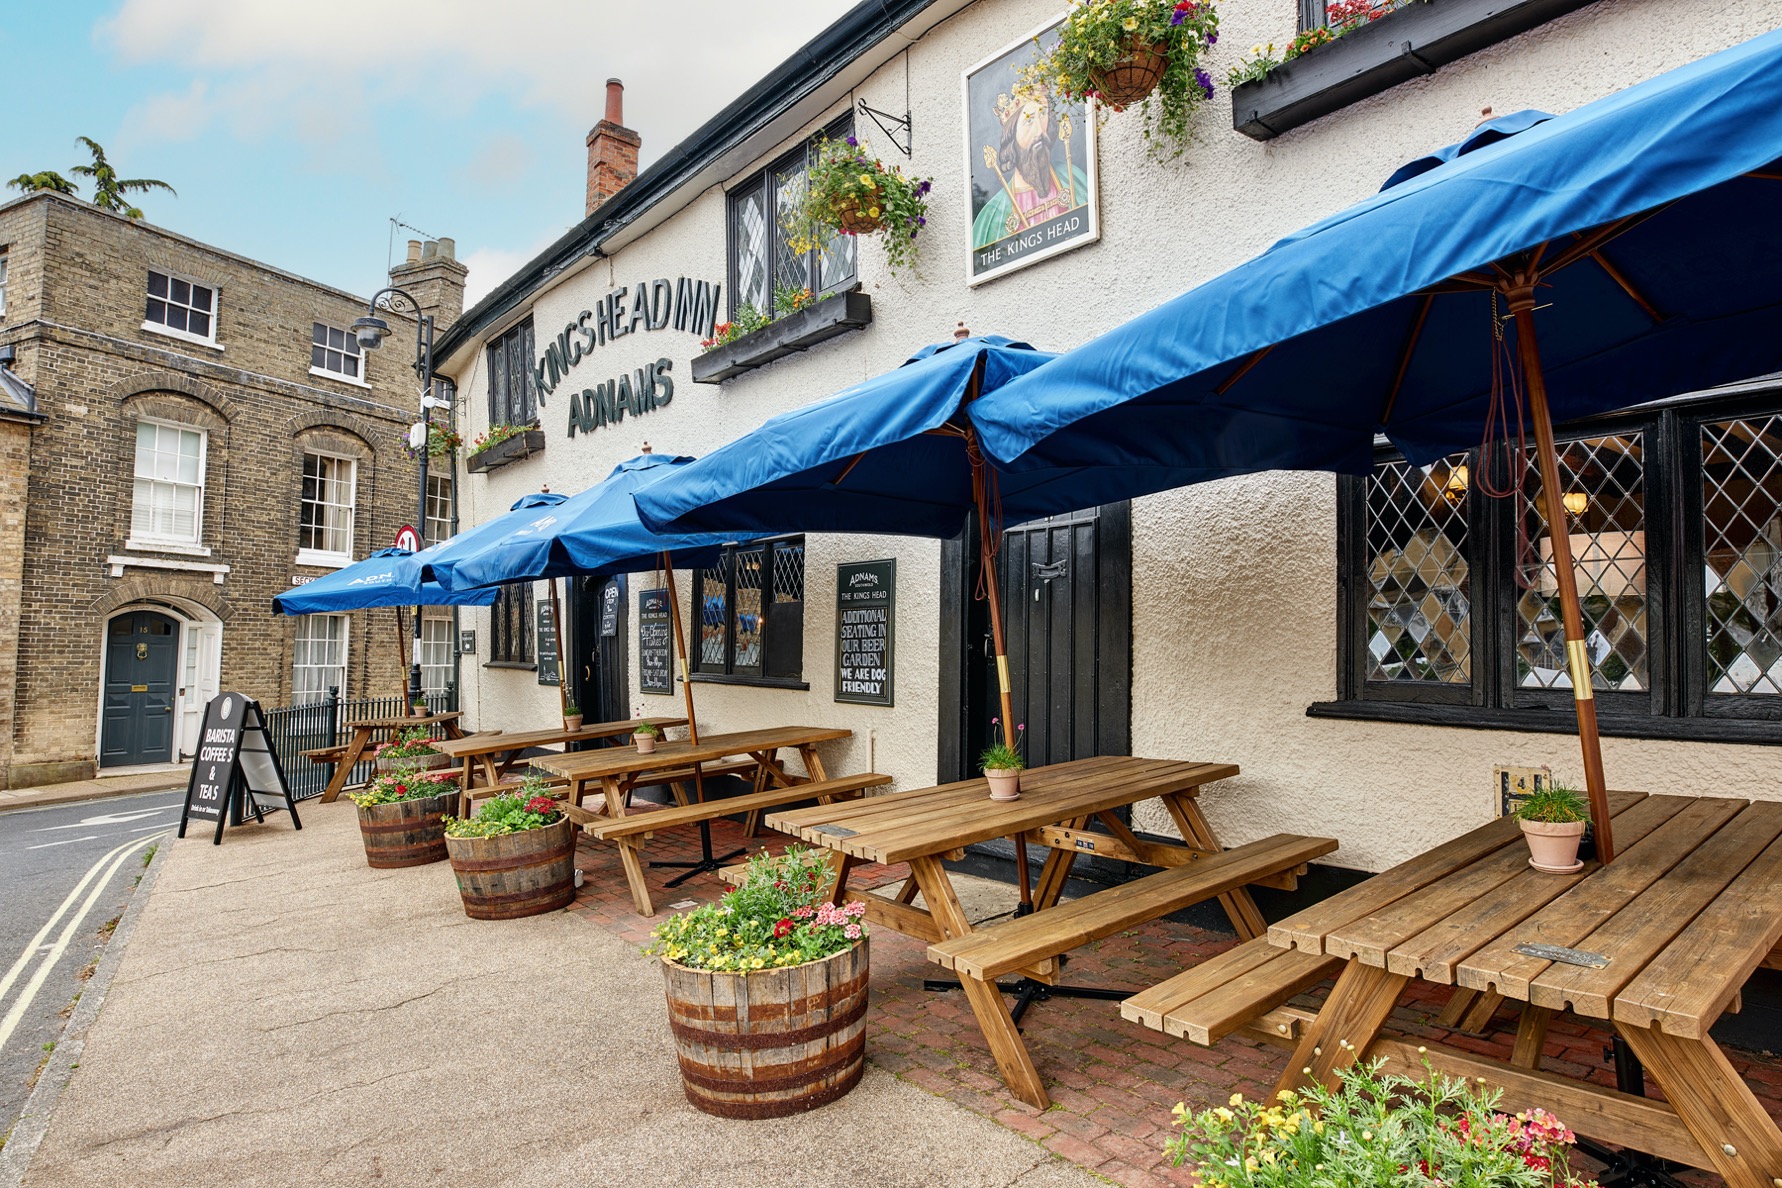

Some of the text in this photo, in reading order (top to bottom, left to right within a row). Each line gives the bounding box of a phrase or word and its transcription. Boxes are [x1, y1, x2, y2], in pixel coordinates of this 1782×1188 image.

[980, 217, 1080, 266] THE KINGS HEAD
[533, 309, 596, 408] KINGS
[596, 278, 673, 347] HEAD
[567, 357, 674, 438] ADNAMS
[295, 576, 315, 585] SECK
[347, 572, 395, 586] ADN
[848, 572, 879, 587] ADNAMS
[604, 586, 619, 599] OPEN
[841, 590, 887, 601] THE KINGS HEAD
[842, 609, 887, 624] ADDITIONAL
[841, 624, 887, 639] SEATING IN
[842, 638, 886, 653] OUR BEER
[842, 652, 881, 667] GARDEN
[841, 667, 886, 681] WE ARE DOG
[842, 681, 882, 694] FRIENDLY
[205, 728, 236, 744] BARISTA
[209, 765, 216, 781] &
